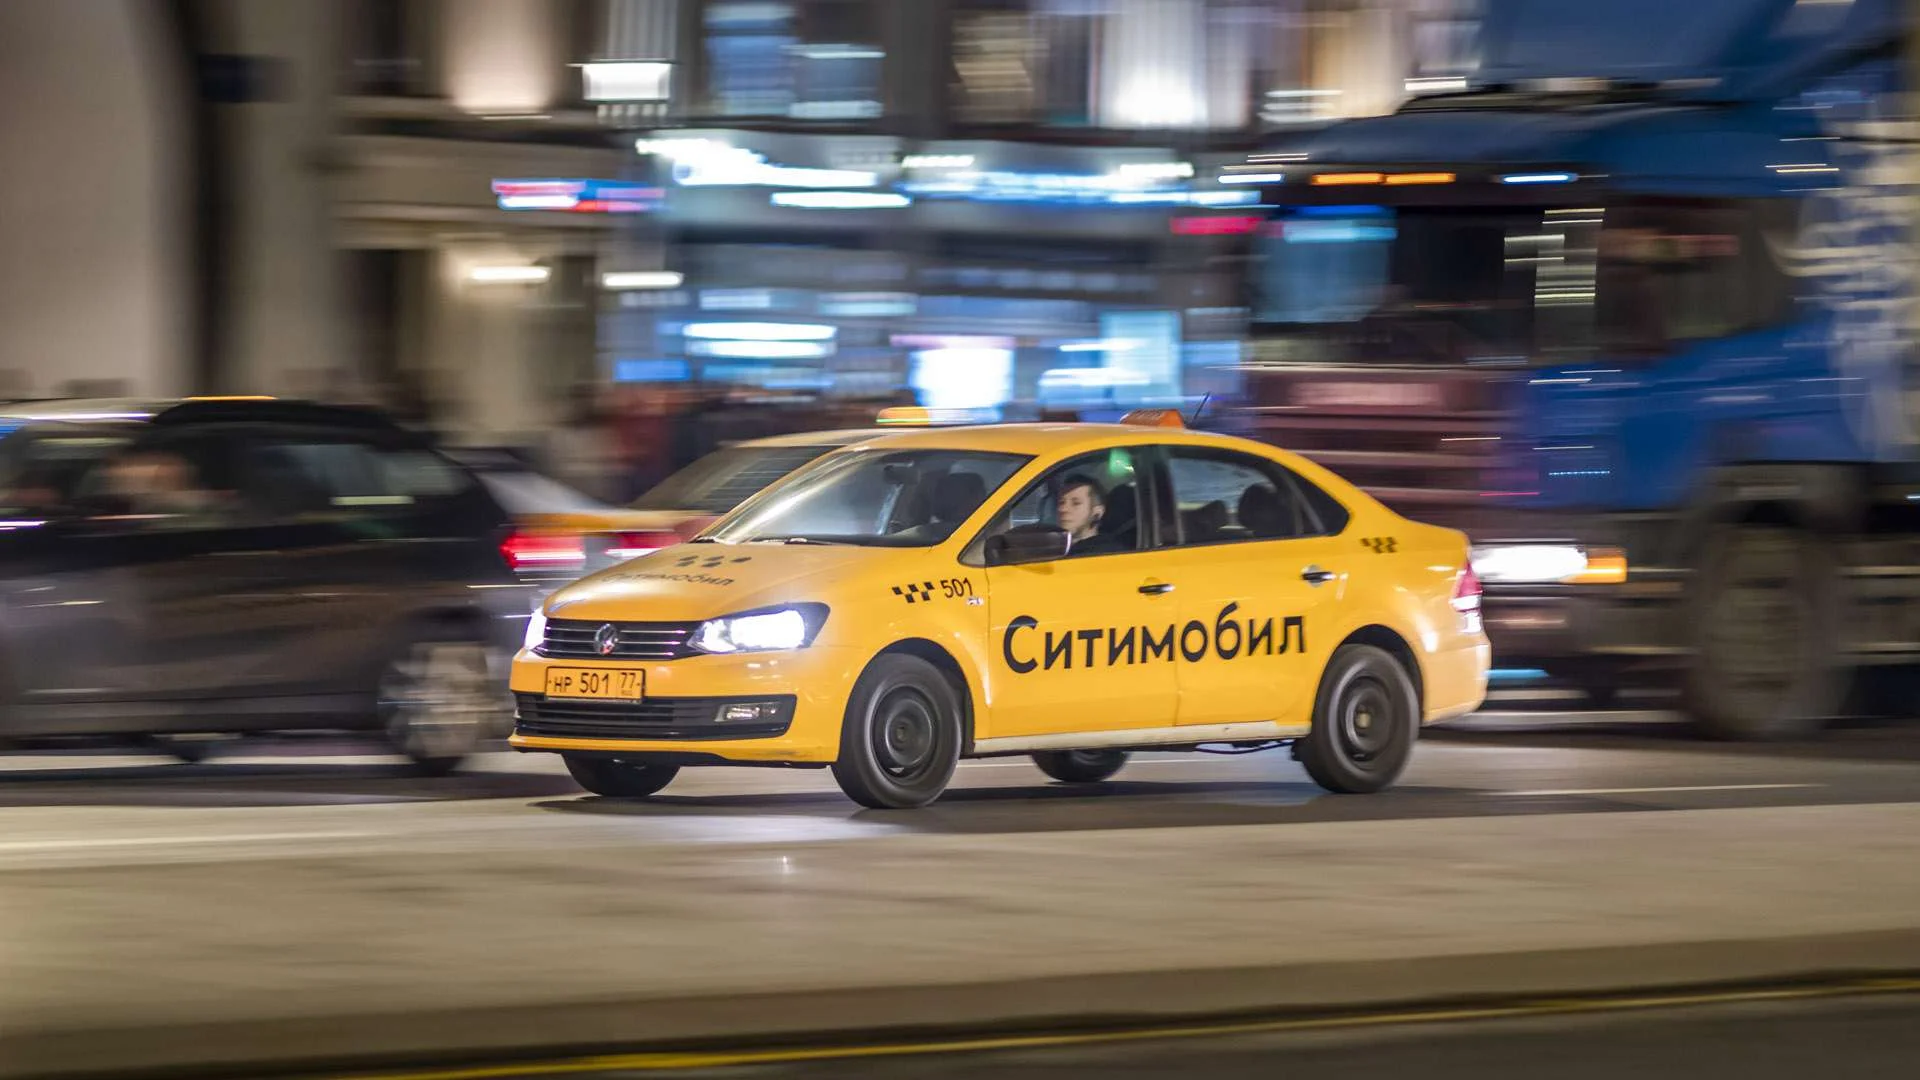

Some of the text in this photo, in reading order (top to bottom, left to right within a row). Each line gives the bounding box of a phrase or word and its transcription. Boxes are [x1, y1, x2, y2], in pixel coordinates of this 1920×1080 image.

[940, 577, 973, 598] 501
[1003, 602, 1306, 674] Ситимобил
[580, 672, 608, 694] 501
[621, 672, 636, 688] 77
